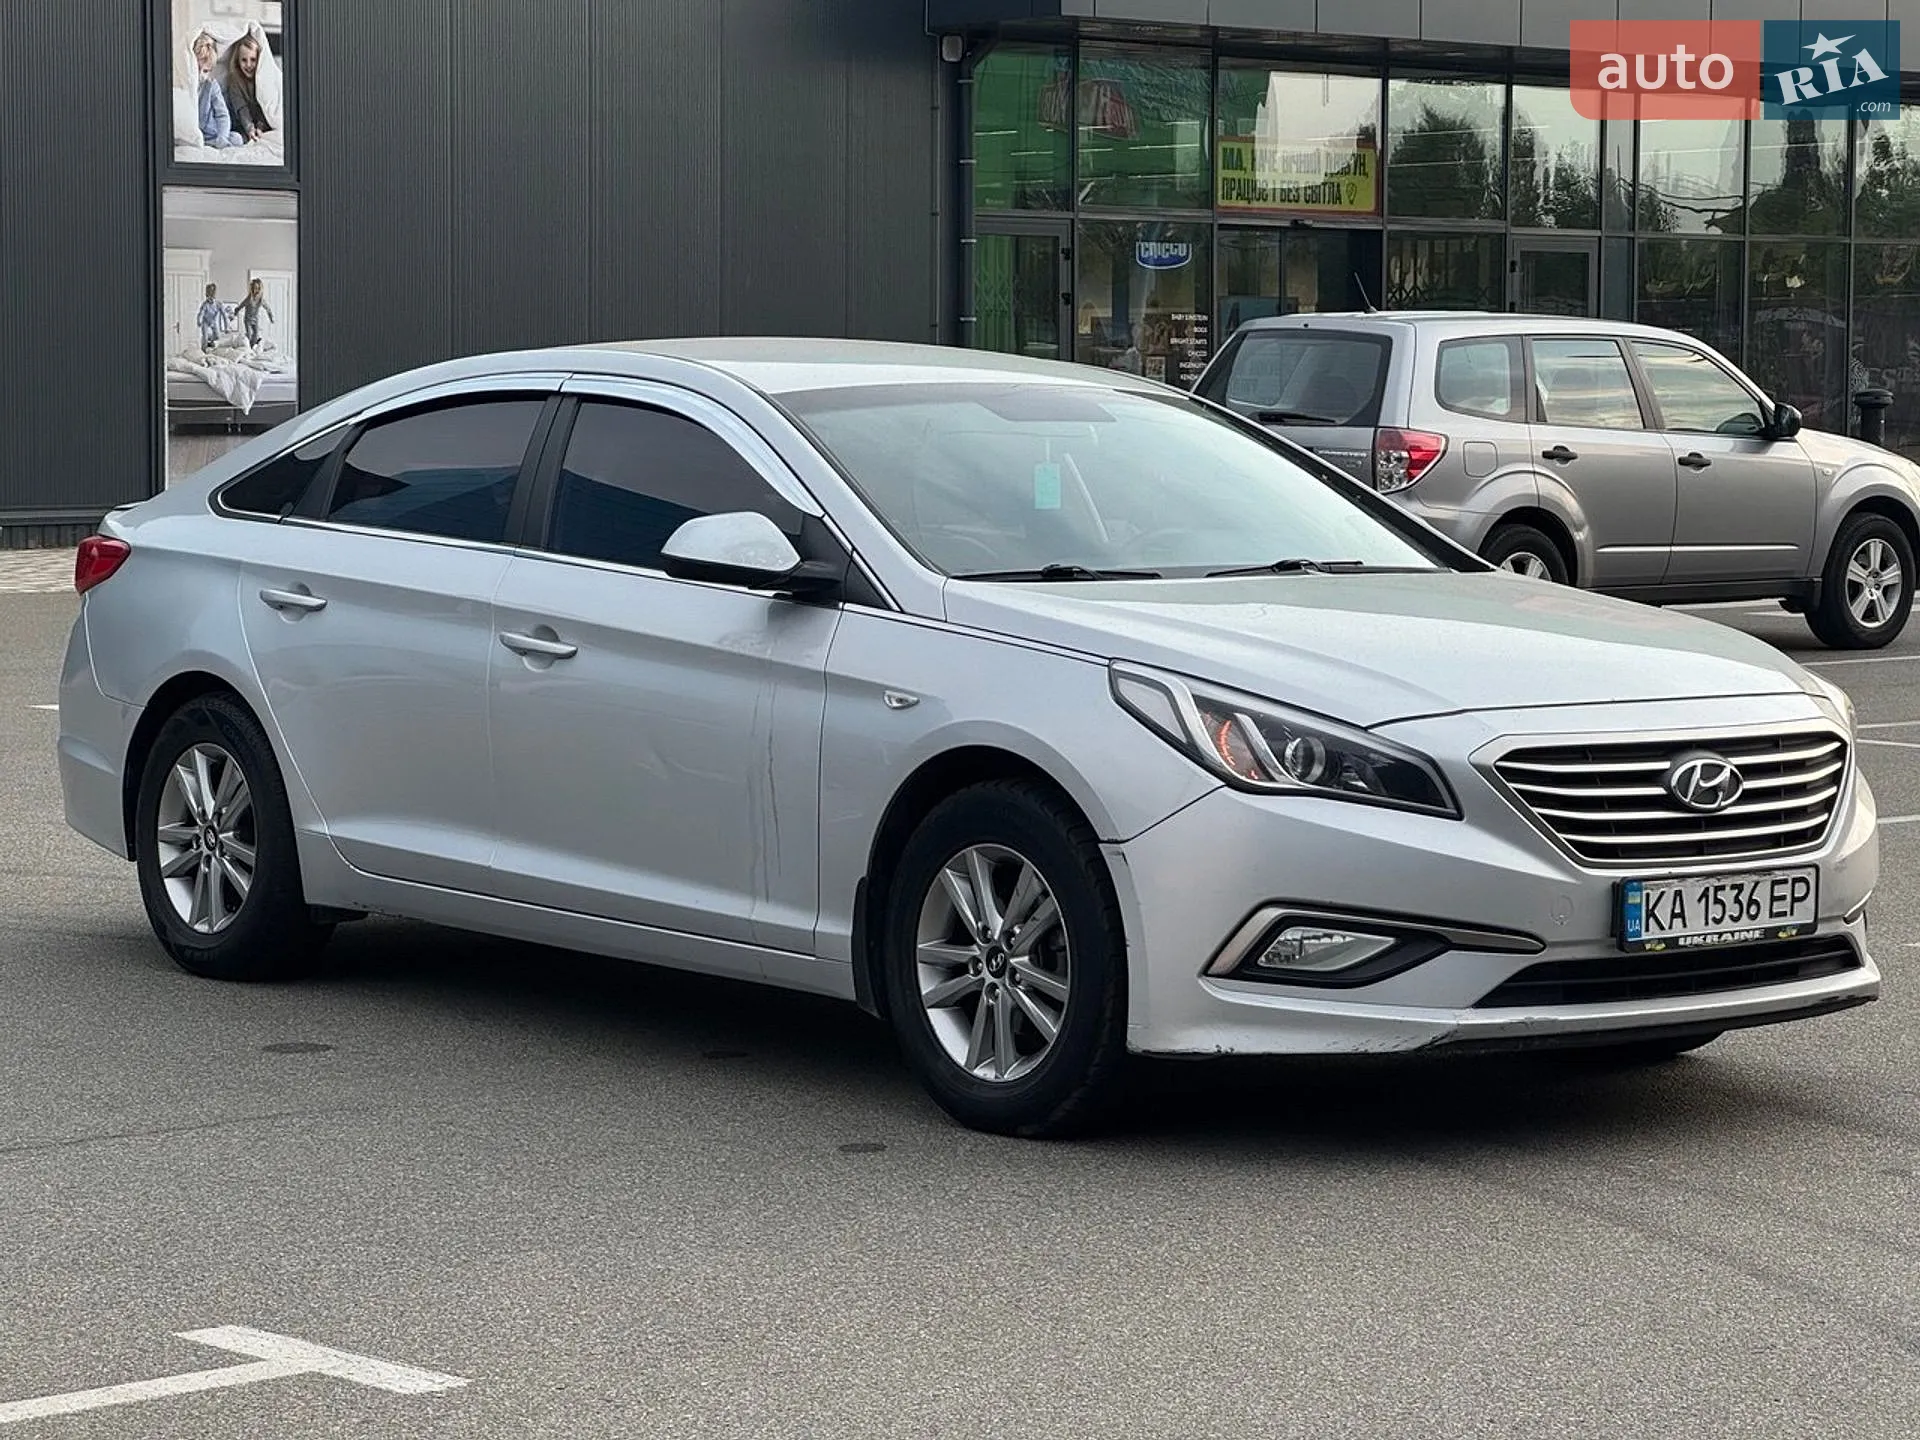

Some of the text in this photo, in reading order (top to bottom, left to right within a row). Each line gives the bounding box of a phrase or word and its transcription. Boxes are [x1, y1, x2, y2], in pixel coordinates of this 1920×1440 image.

[1644, 876, 1811, 933] KA 1536 EP
[1627, 919, 1641, 932] UA
[1678, 928, 1766, 946] UKRAINE
